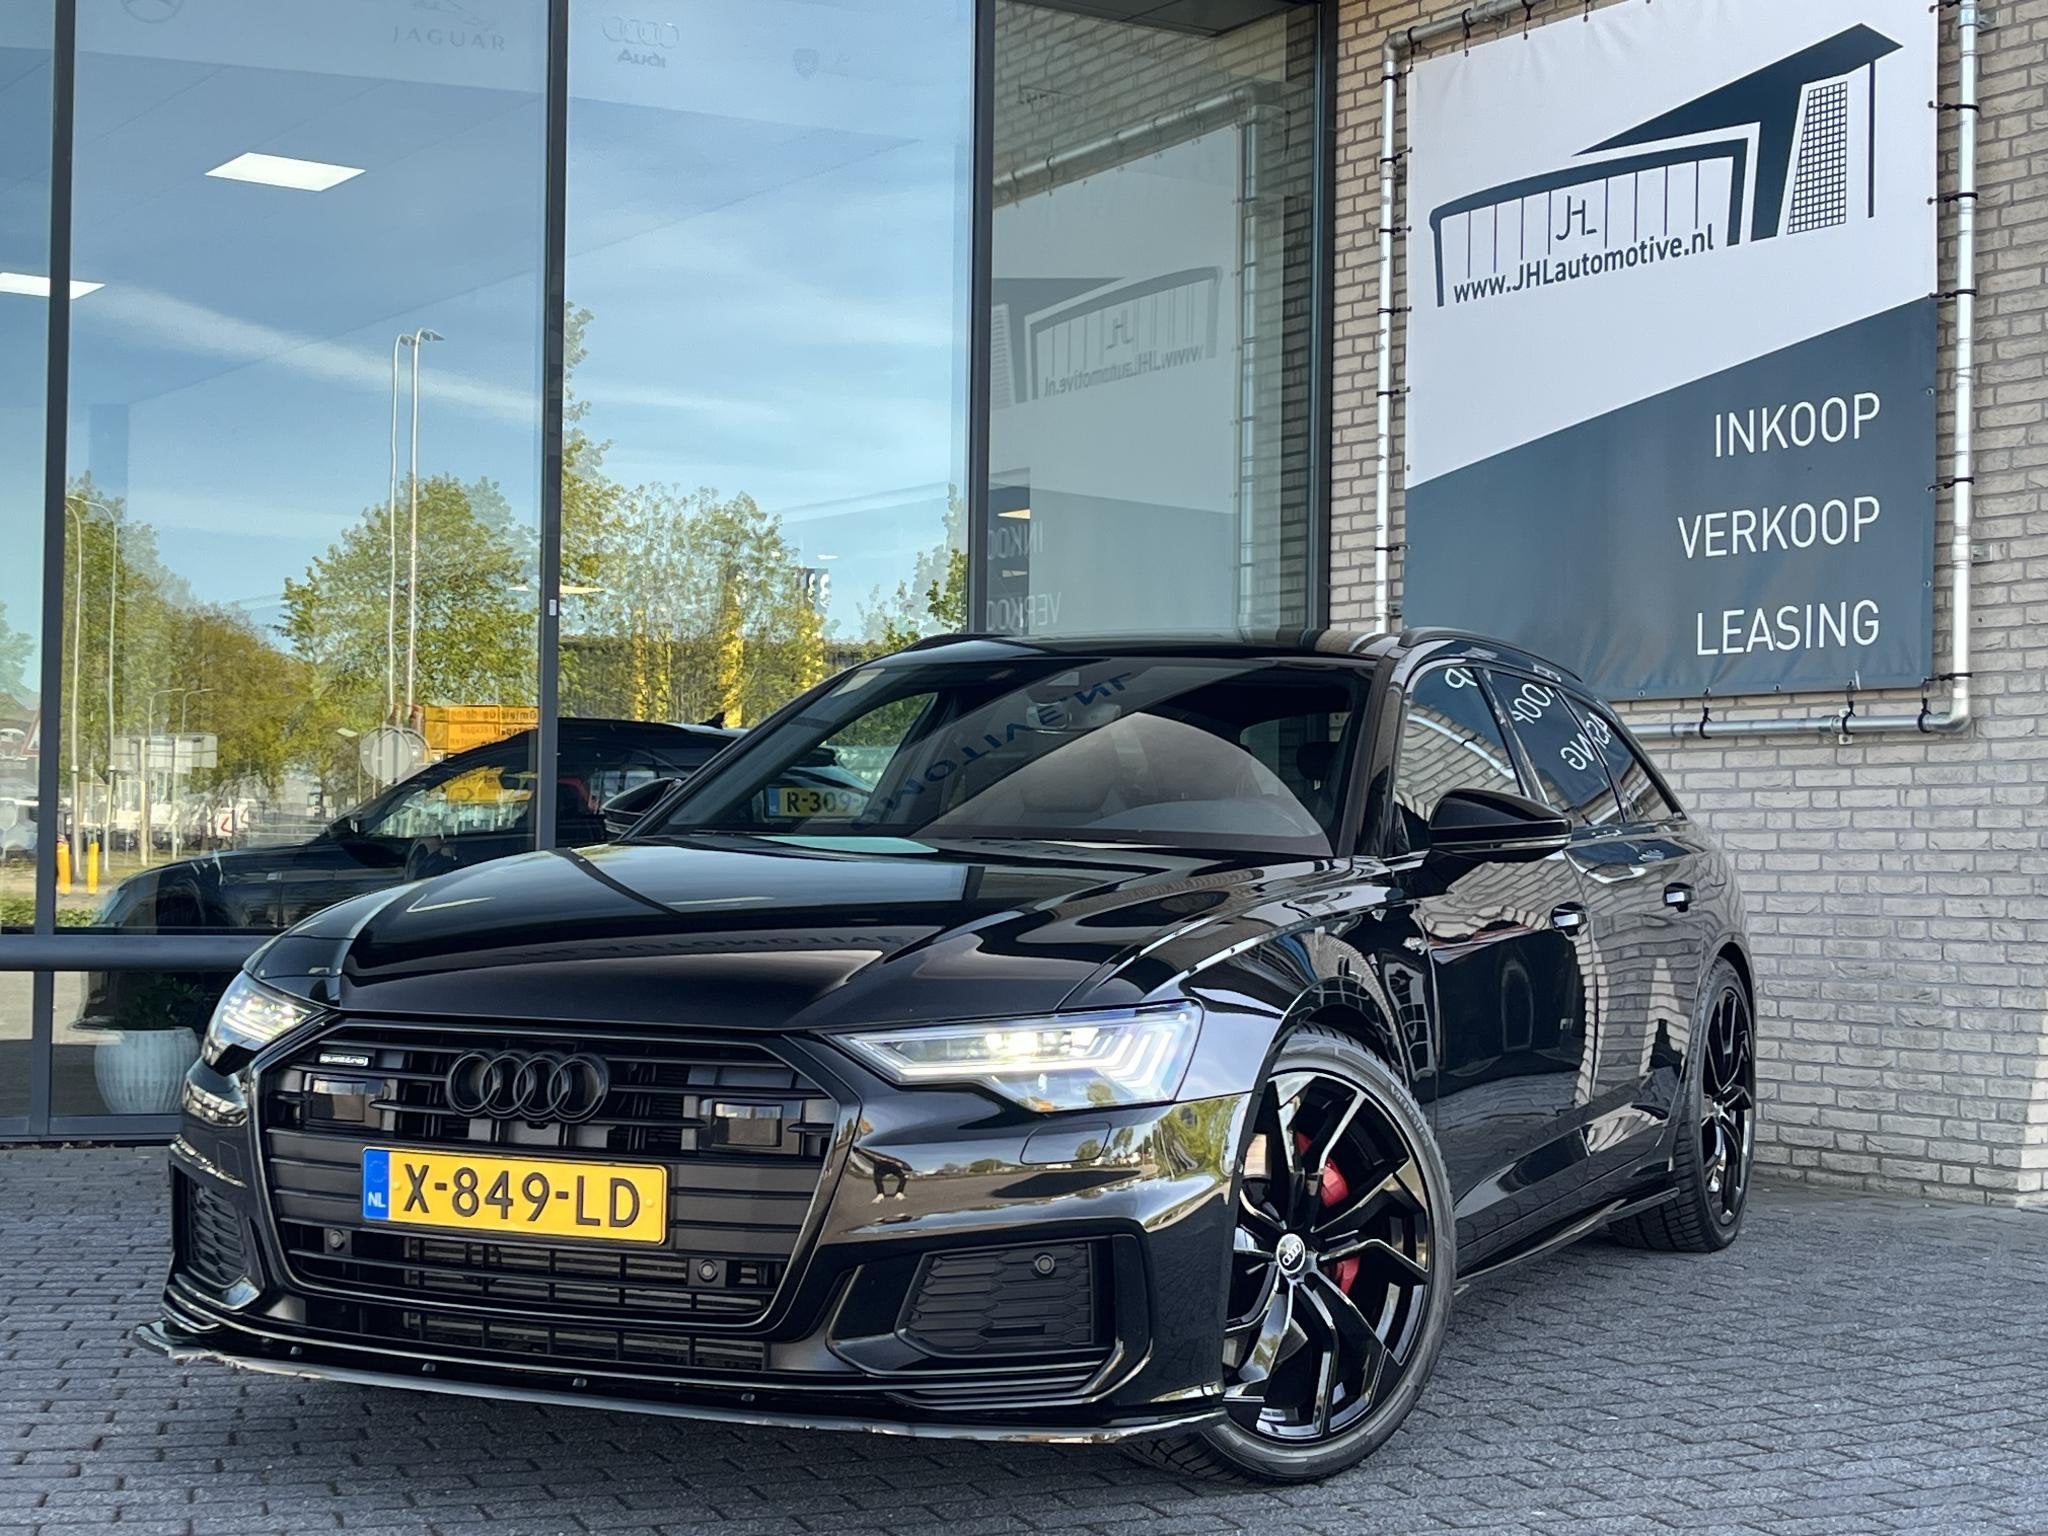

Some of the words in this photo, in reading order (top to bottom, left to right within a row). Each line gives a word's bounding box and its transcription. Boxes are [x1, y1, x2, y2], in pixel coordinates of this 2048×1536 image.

[393, 25, 506, 51] JAGUAR
[617, 48, 667, 69] Audi
[1454, 223, 1714, 303] www.JHLautomotive.nl
[1714, 392, 1881, 458] INKOOP
[1677, 496, 1881, 559] VERKOOP
[1697, 599, 1880, 656] LEASING
[367, 1191, 387, 1208] NL
[403, 1163, 641, 1229] X-849-LD
